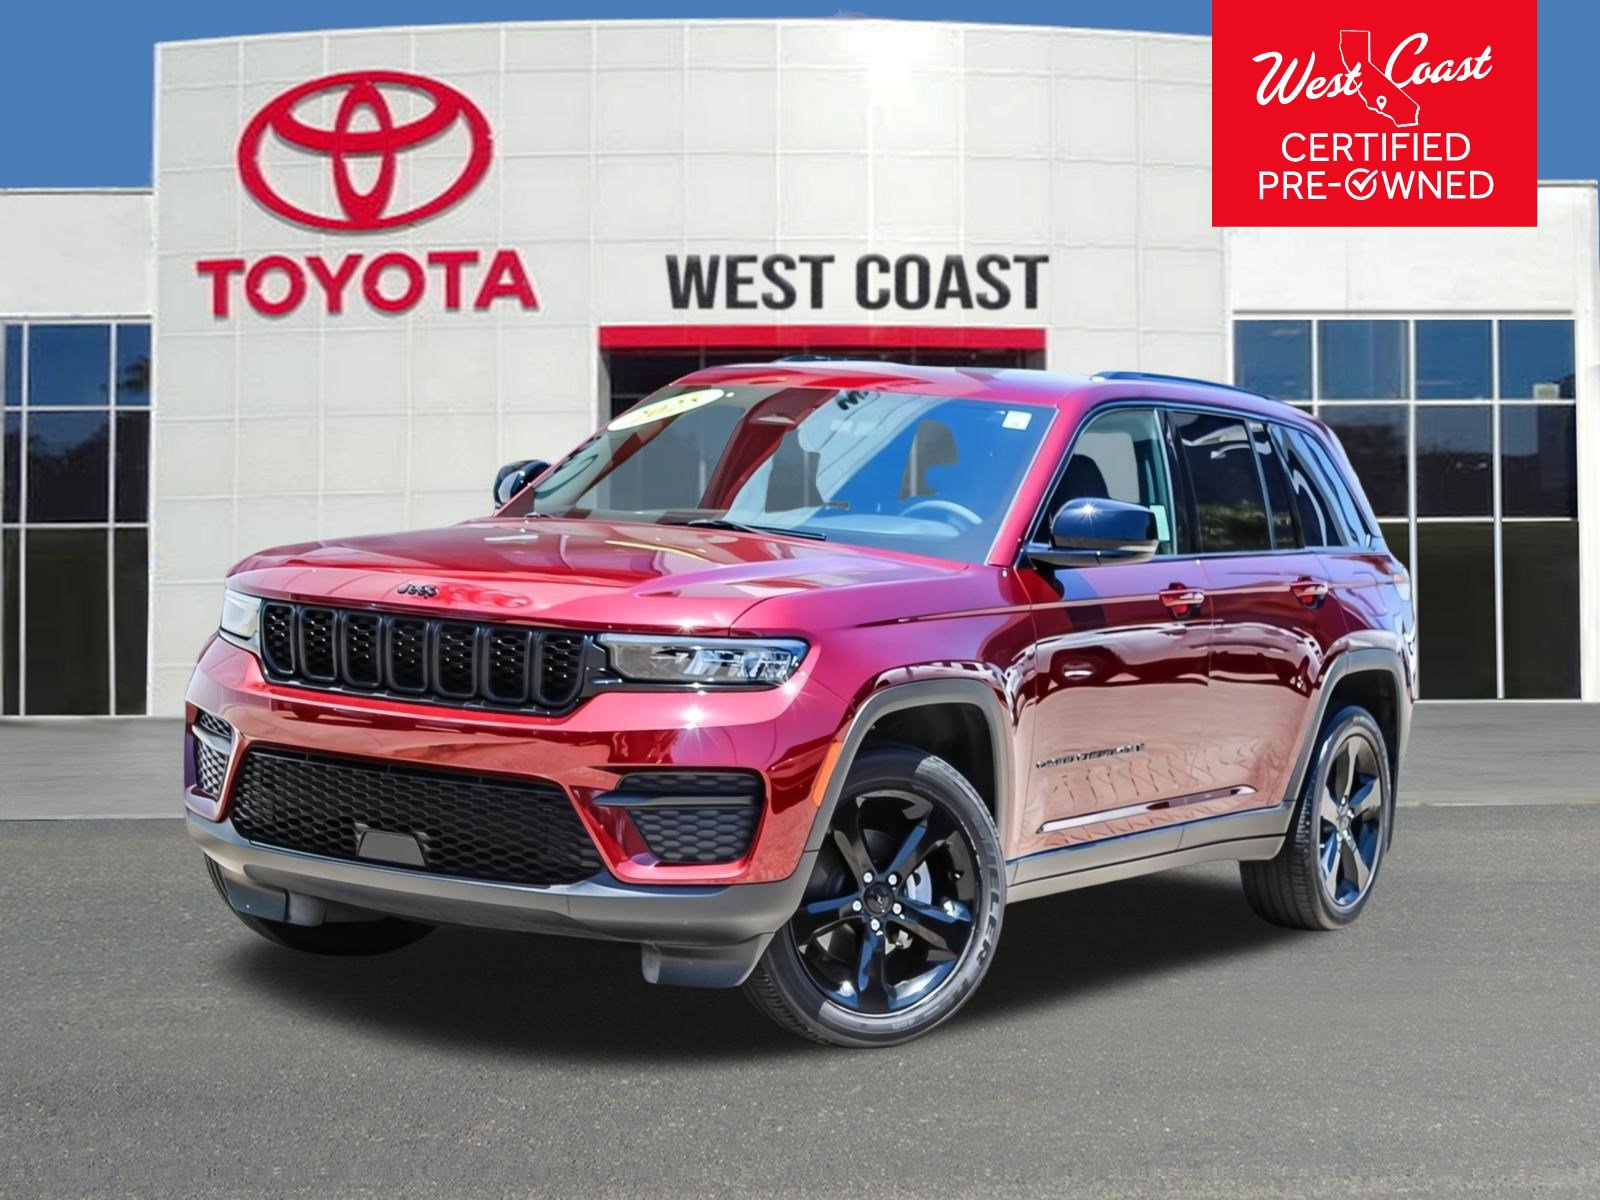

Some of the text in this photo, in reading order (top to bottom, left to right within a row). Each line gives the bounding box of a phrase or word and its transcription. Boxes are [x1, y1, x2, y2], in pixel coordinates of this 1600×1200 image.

[196, 249, 539, 318] TOYOTA
[666, 254, 1049, 310] WEST COAST
